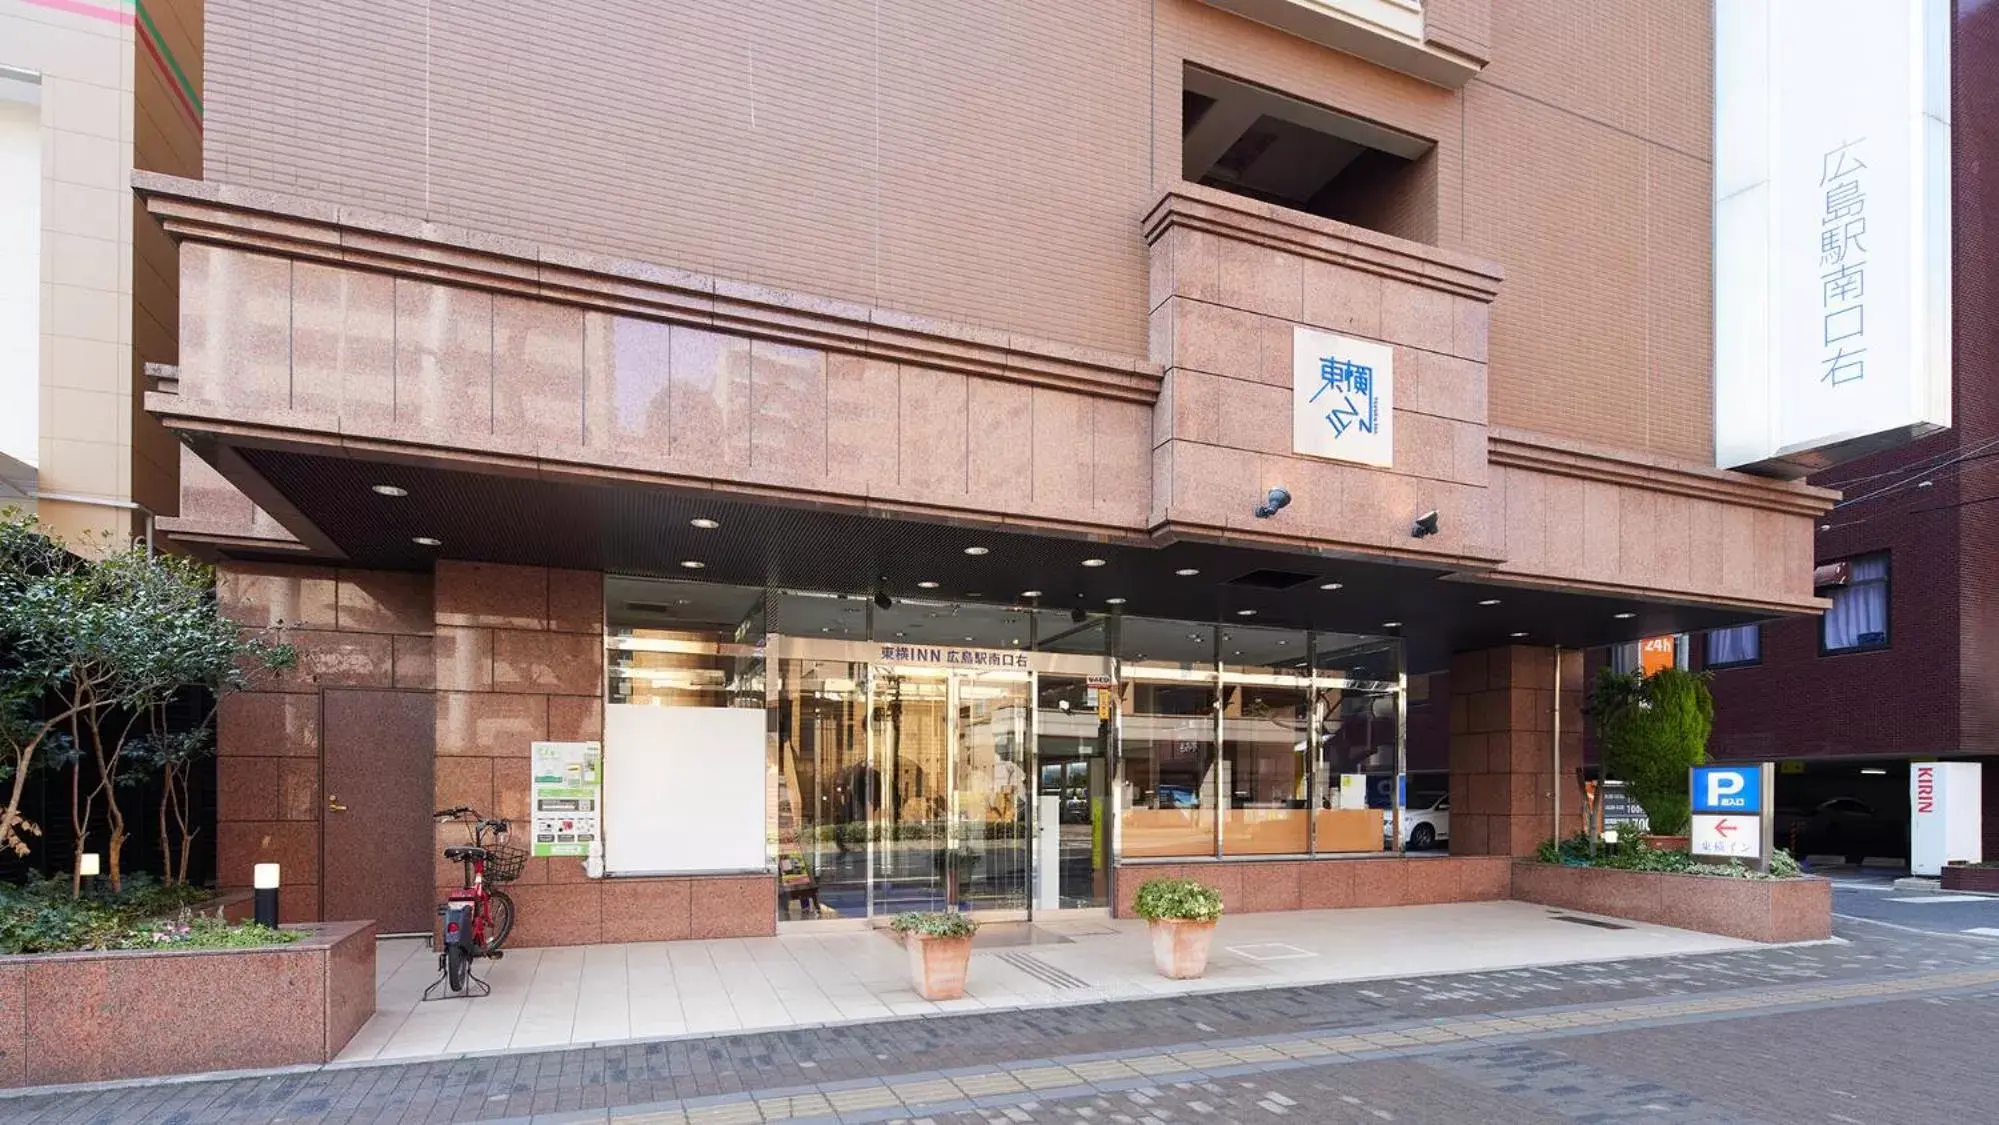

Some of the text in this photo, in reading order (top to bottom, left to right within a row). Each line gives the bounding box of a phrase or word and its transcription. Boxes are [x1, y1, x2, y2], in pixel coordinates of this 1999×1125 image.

[1819, 136, 1867, 388] 広島駅南口右
[881, 646, 1028, 667] 東横INN 広島駅南口右
[1707, 771, 1744, 806] P
[1918, 767, 1933, 813] KIRIN
